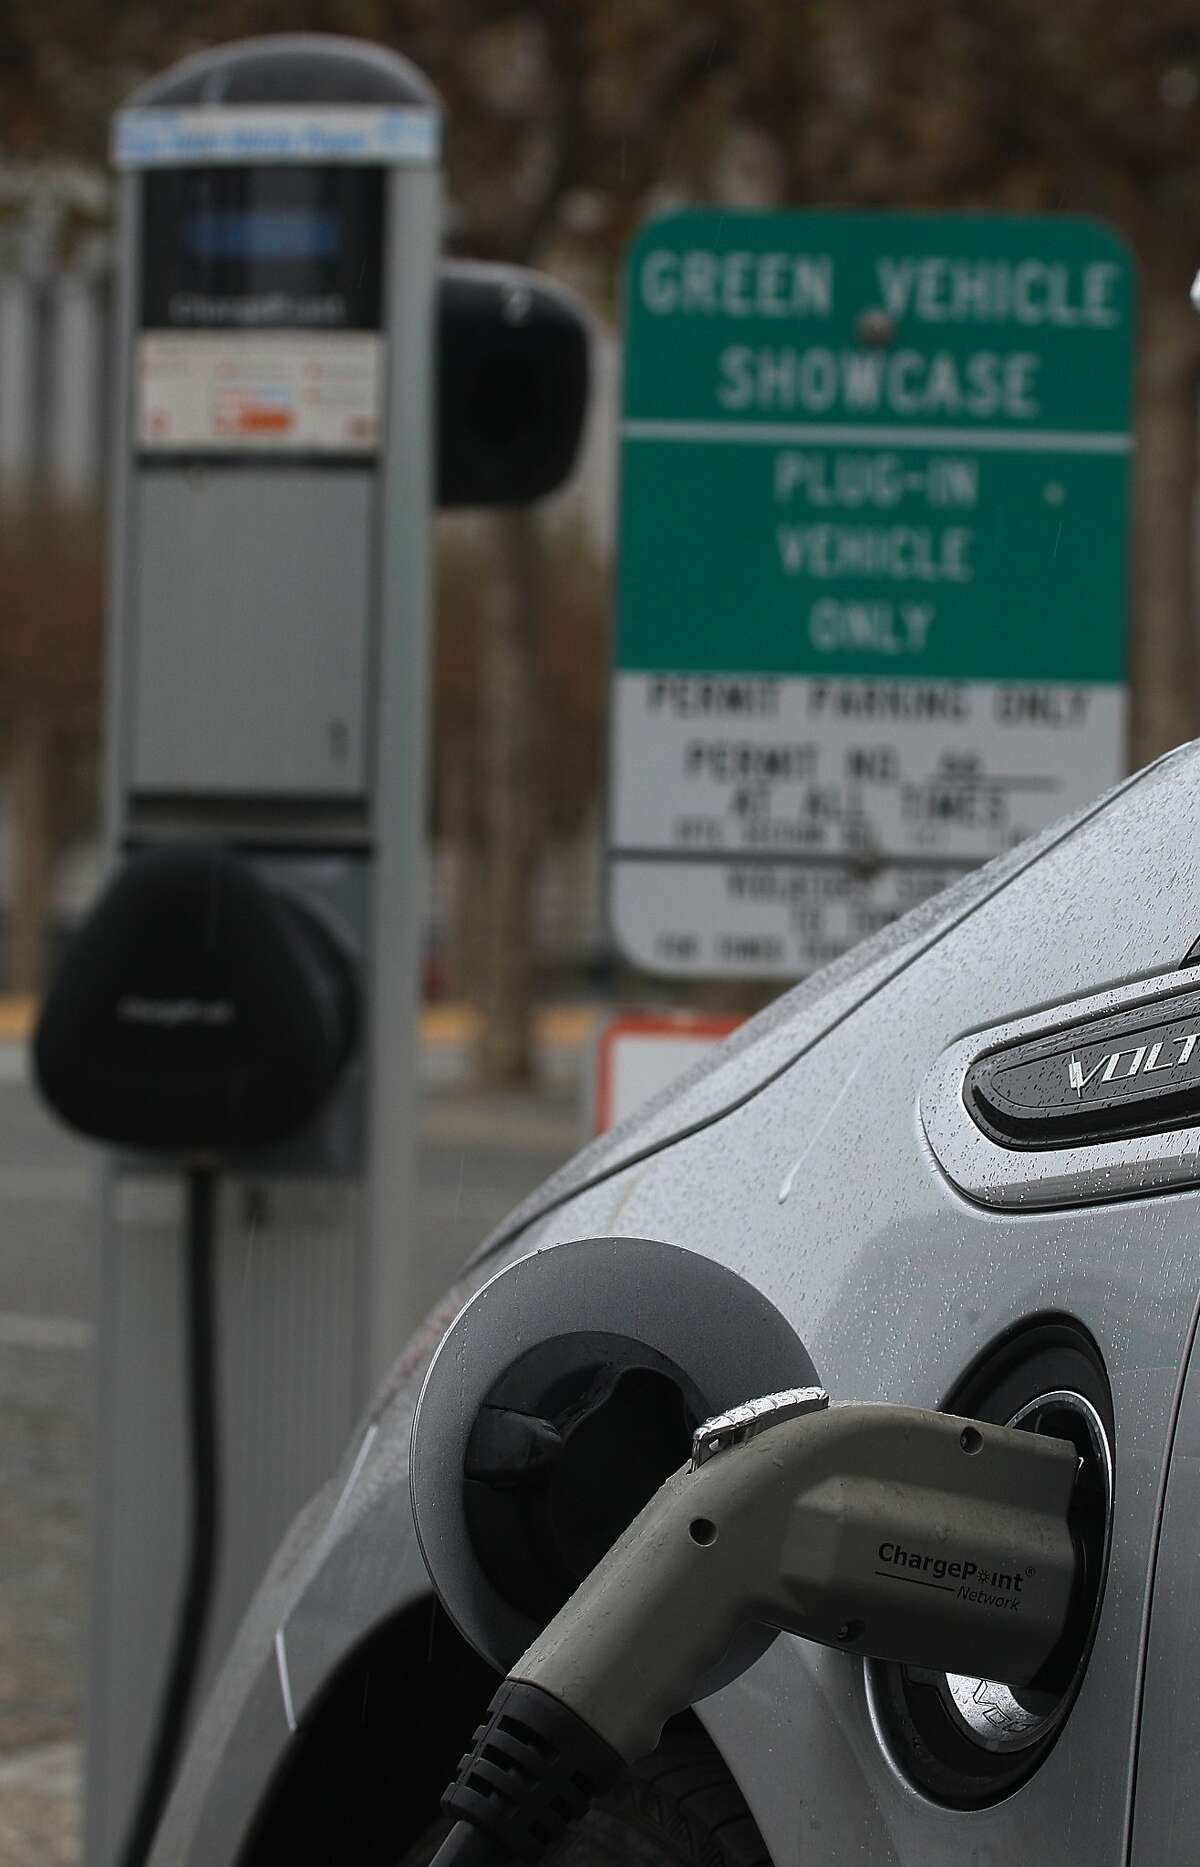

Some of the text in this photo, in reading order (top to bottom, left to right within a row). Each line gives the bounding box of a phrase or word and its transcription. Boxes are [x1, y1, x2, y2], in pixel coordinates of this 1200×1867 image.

[640, 249, 1120, 328] GREEN VEHICLE
[717, 345, 1039, 417] SHOWCASE
[774, 451, 978, 508] PLUG-IN
[777, 523, 972, 581] VEHICLE
[809, 598, 933, 654] ONLY
[646, 675, 1089, 728] PERMIT PARKING ONLY
[684, 739, 817, 782] PERMIT
[902, 784, 1008, 825] TIMES
[1069, 1033, 1200, 1098] VOLT
[956, 1586, 1020, 1611] Network
